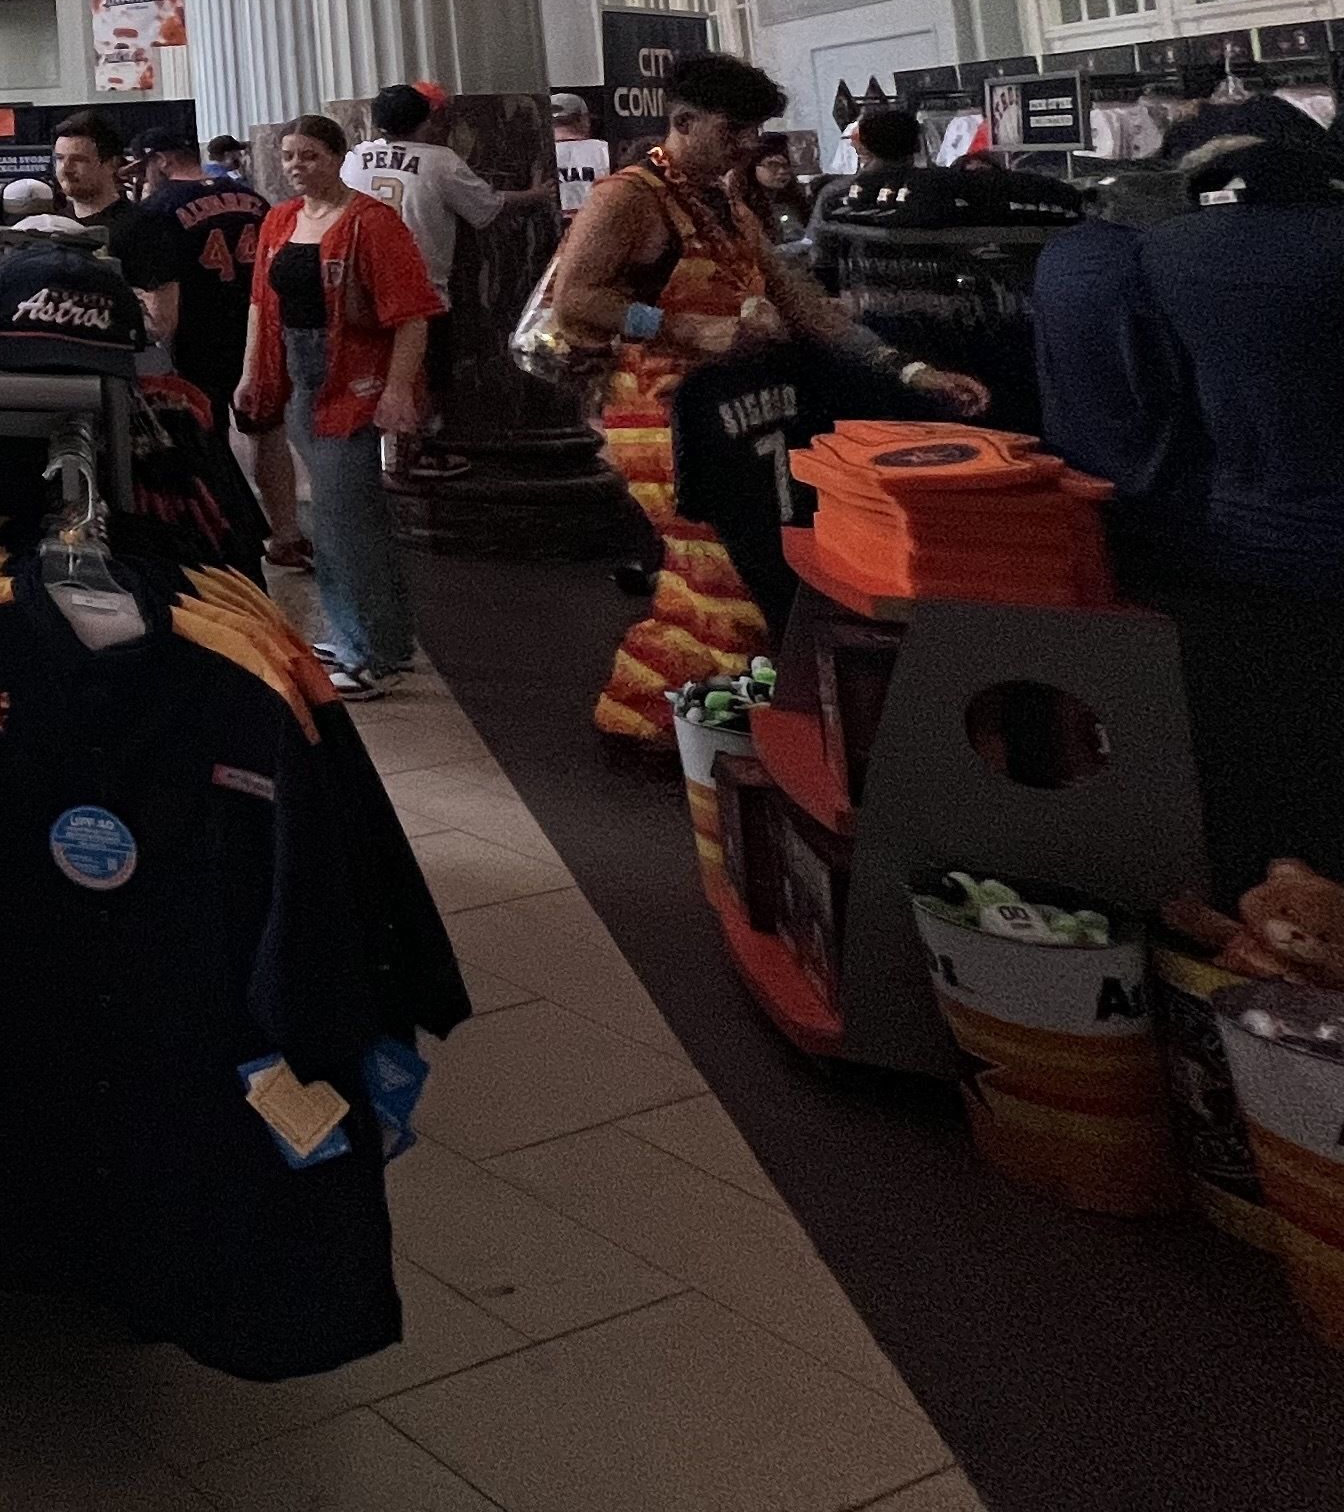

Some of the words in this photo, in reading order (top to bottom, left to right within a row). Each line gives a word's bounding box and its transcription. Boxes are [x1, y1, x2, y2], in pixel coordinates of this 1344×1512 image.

[638, 47, 675, 78] CIT
[361, 145, 420, 175] PEÑA
[12, 288, 112, 330] Astros
[752, 429, 795, 522] 7
